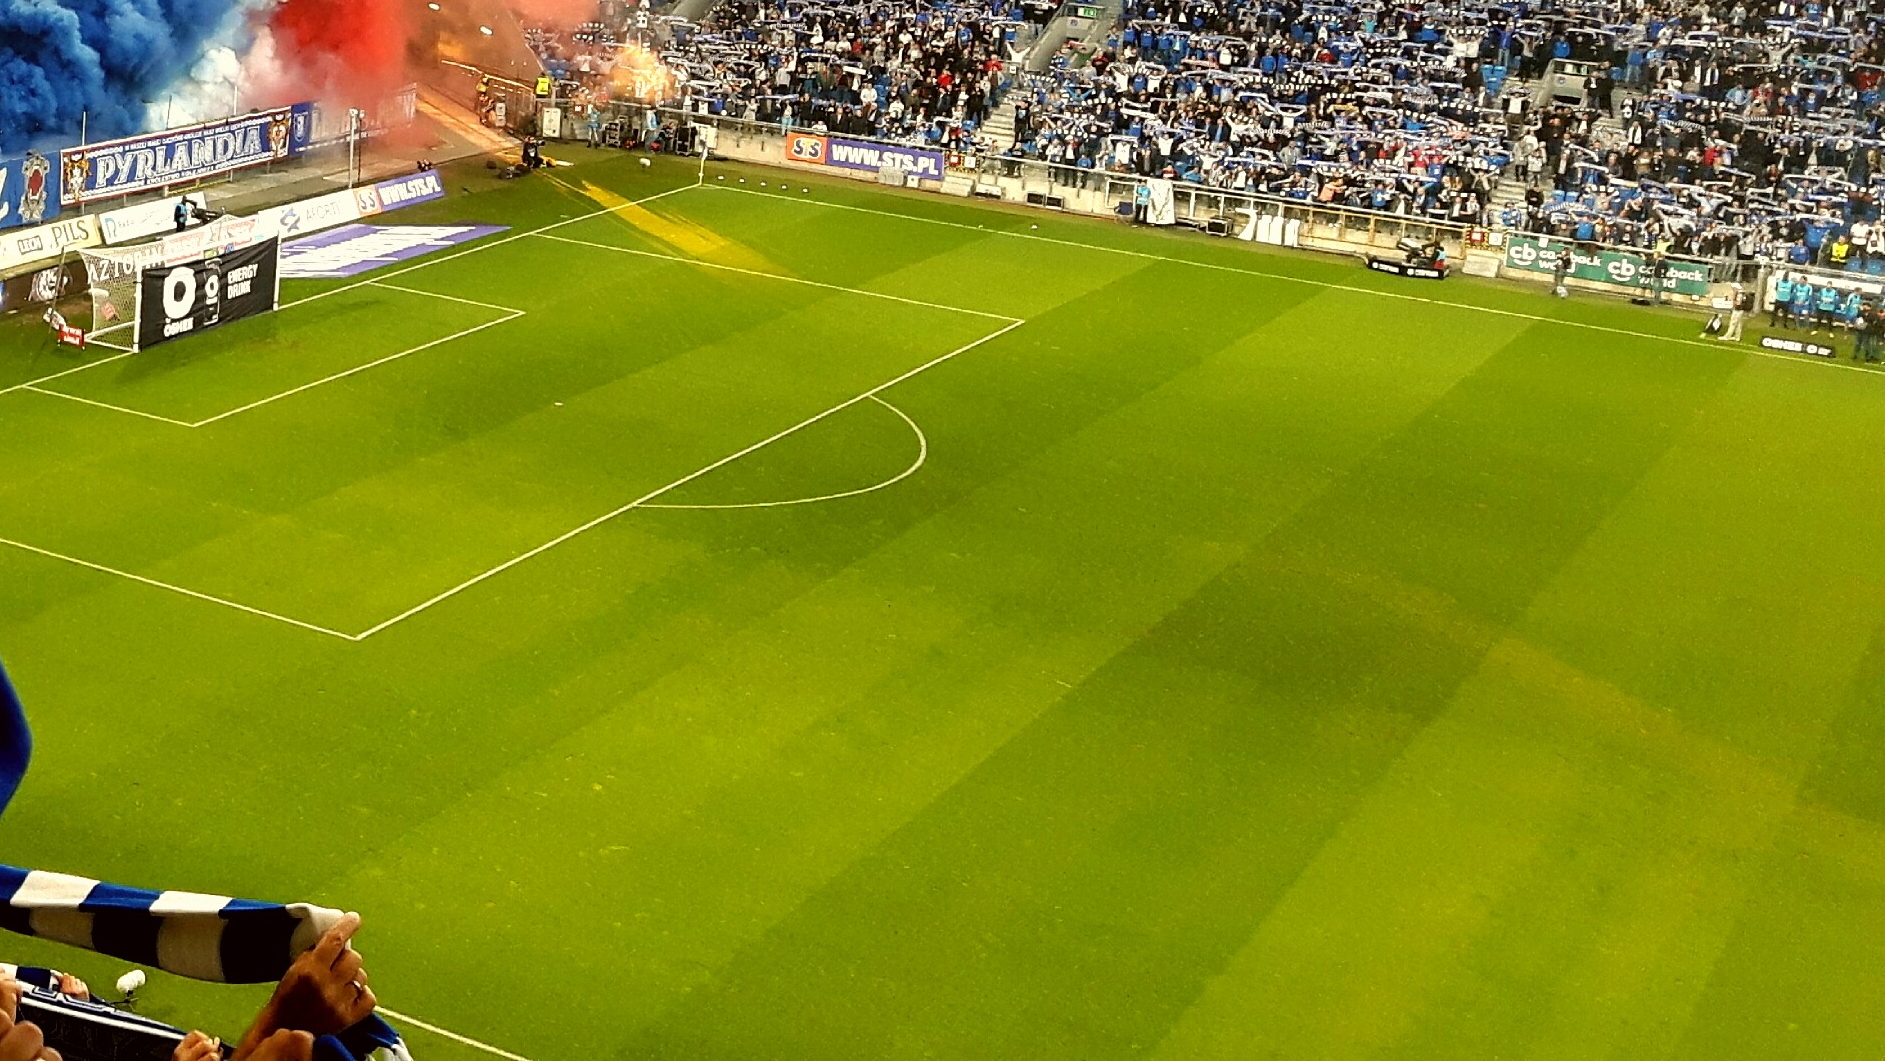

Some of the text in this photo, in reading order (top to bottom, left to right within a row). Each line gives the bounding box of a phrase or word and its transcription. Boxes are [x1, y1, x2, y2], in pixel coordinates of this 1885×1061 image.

[95, 125, 263, 188] PYRLANDIA
[832, 143, 939, 176] WWW.STS.PL
[377, 175, 442, 206] WWW.STS.PL
[19, 236, 44, 255] LECH
[51, 219, 90, 251] PILS
[226, 263, 259, 283] ENERGY
[1539, 249, 1602, 267] caback
[226, 280, 252, 300] DRINK
